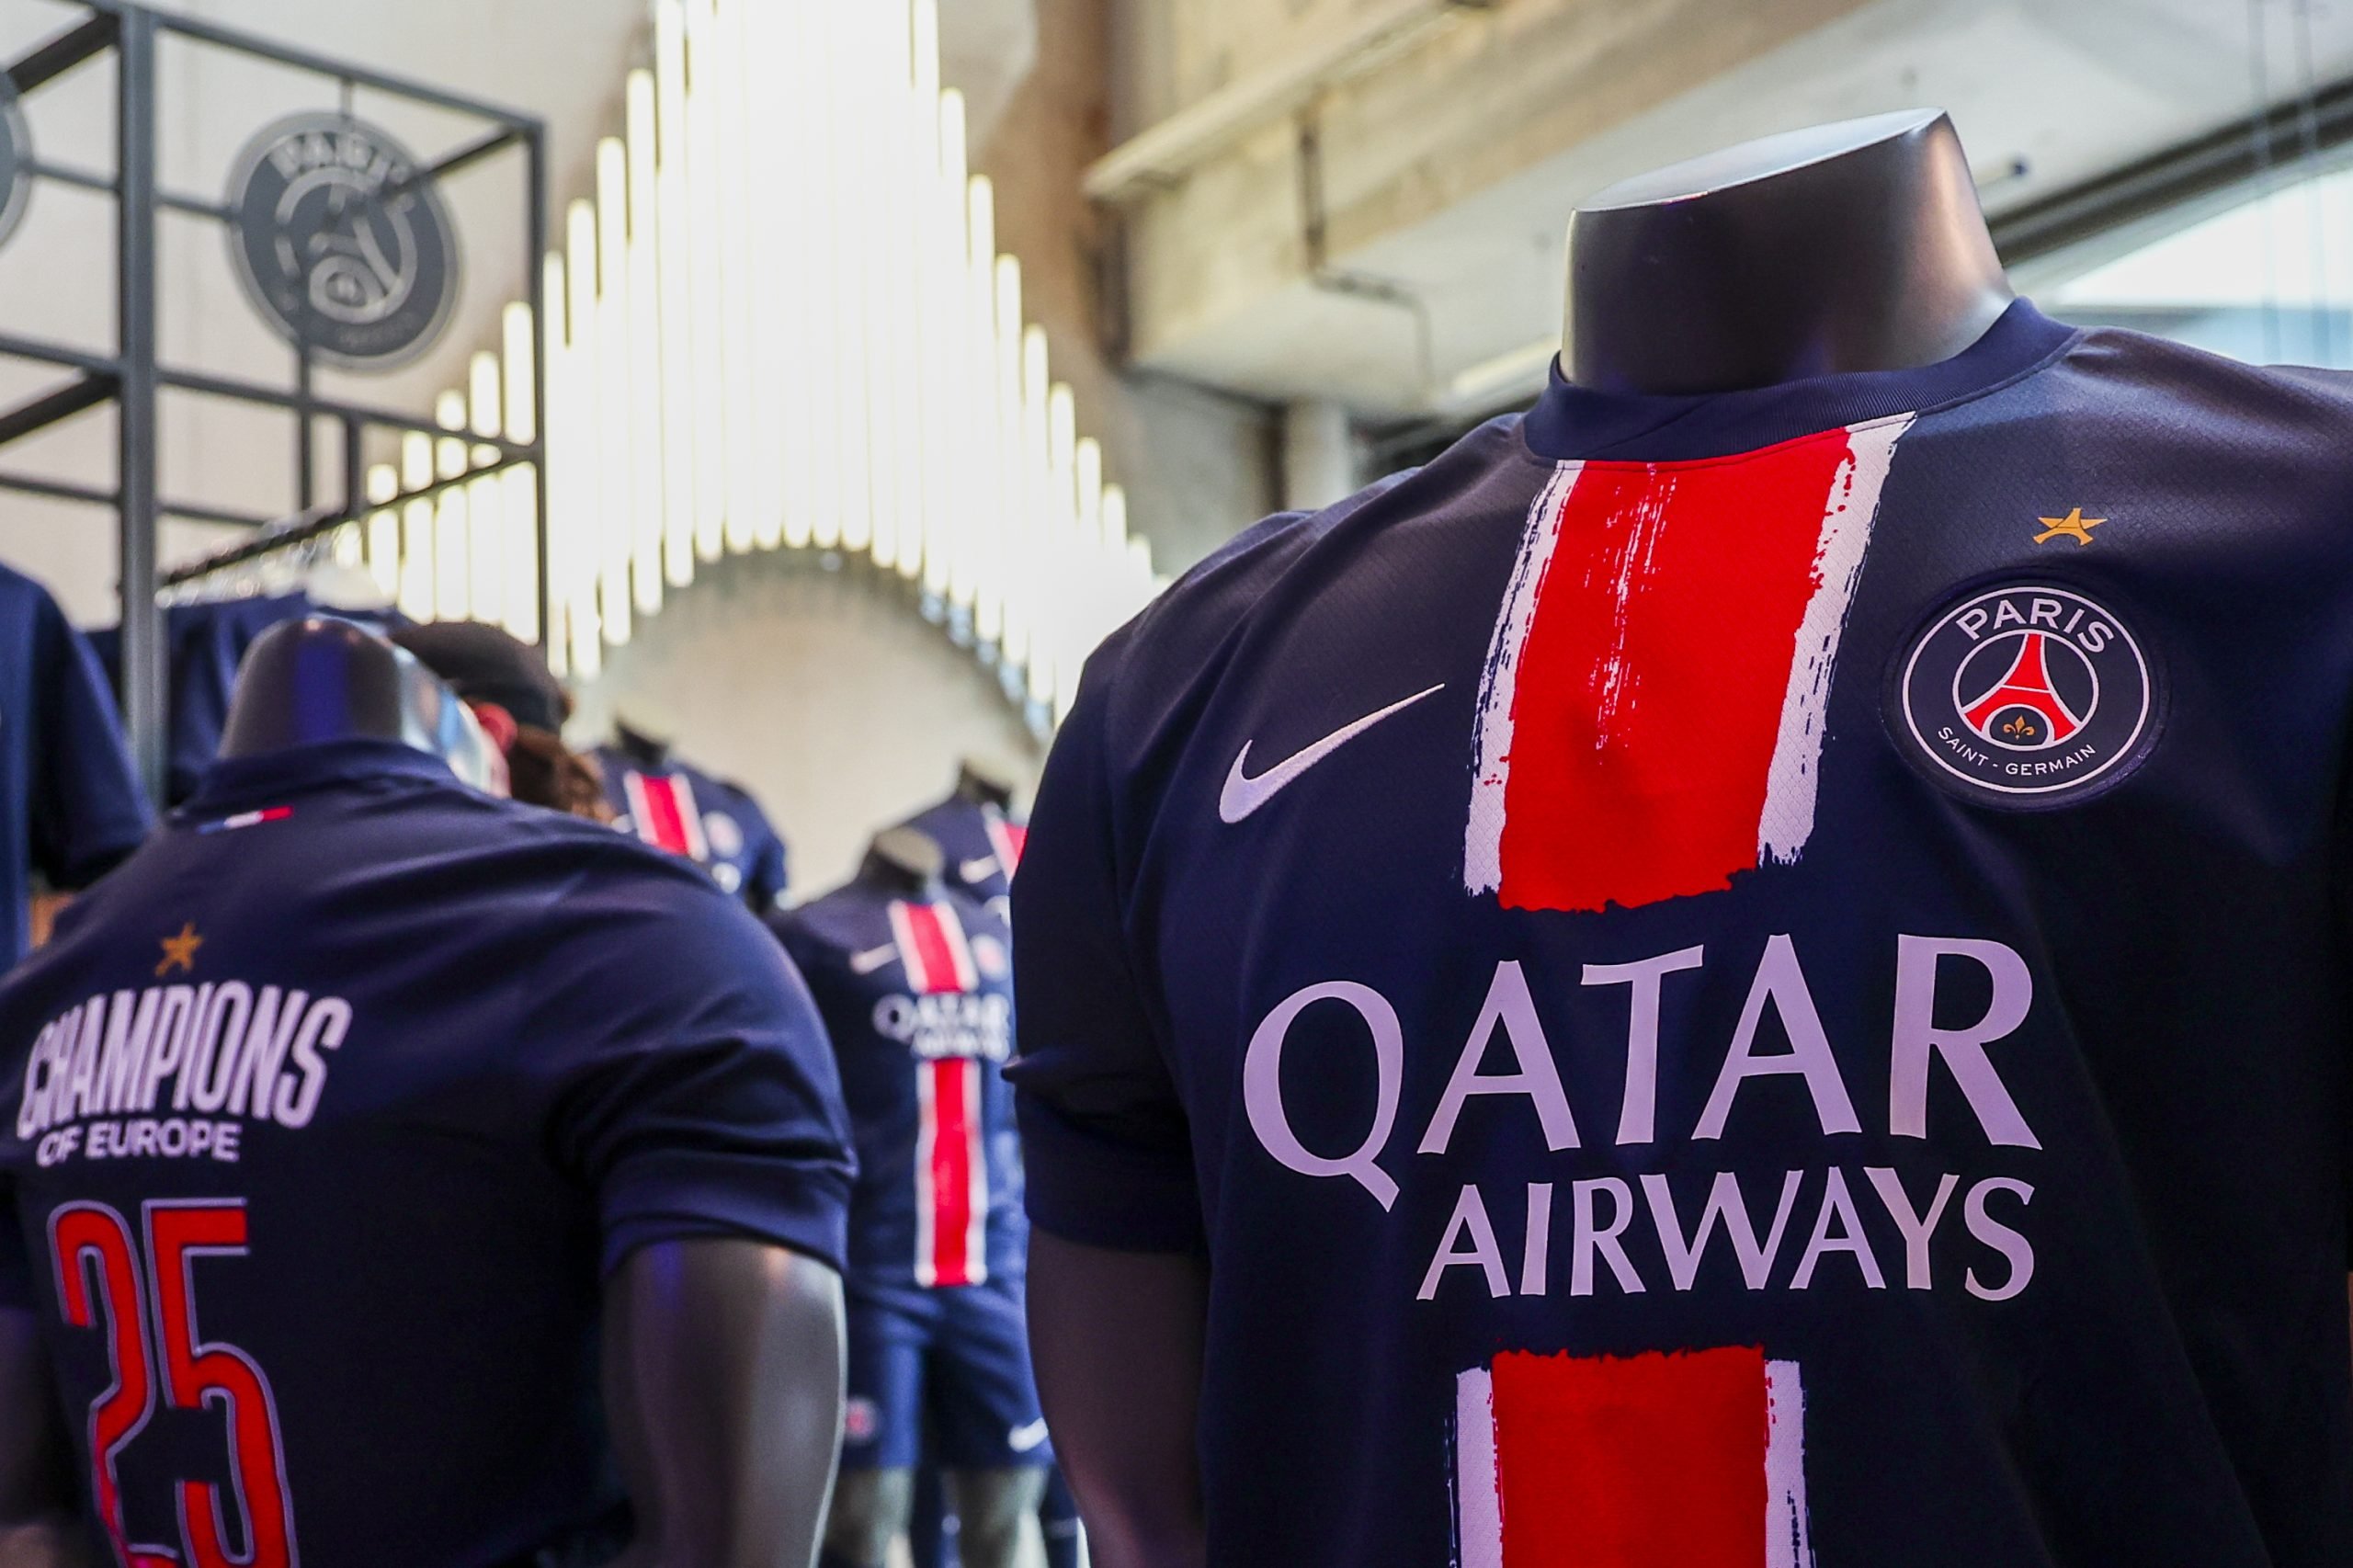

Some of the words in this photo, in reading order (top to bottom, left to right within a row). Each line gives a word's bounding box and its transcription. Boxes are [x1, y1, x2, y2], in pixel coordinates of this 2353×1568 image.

[1955, 597, 2115, 653] PARIS
[2005, 744, 2096, 776] GERMAIN
[17, 979, 353, 1140] CHAMPIONS
[1244, 933, 2042, 1212] QATAR
[36, 1124, 84, 1167] OF
[85, 1118, 243, 1163] EUROPE
[1416, 1166, 2035, 1301] AIRWAYS
[46, 1198, 301, 1568] 25
